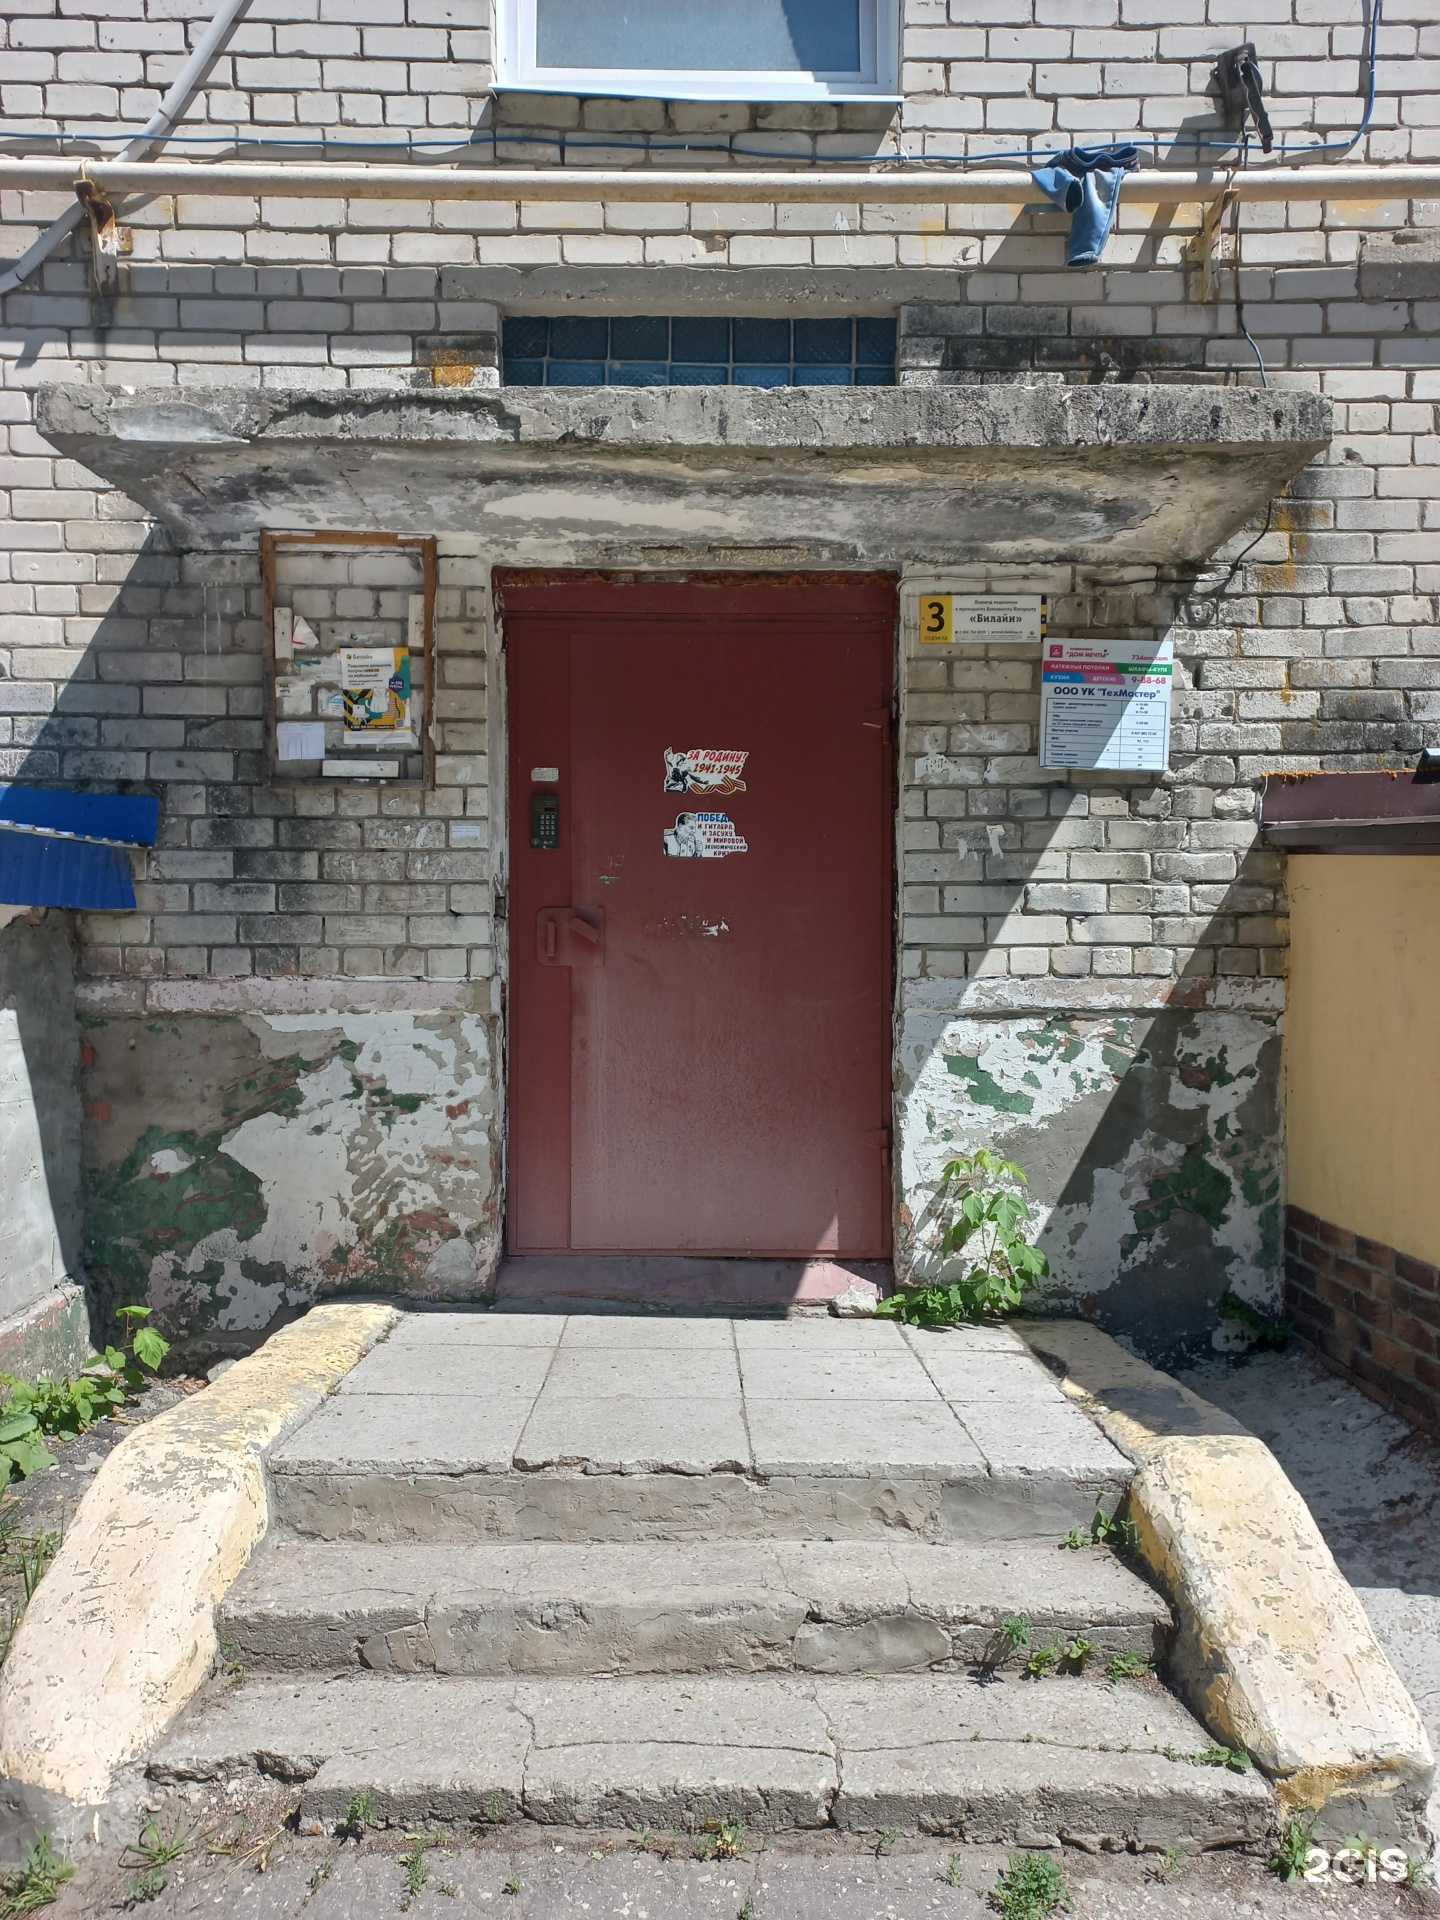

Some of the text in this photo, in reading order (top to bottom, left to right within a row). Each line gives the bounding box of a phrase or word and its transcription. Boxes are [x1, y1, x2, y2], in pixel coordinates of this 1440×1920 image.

[926, 601, 945, 632] 3
[969, 613, 1022, 623] «Билайн»
[1054, 687, 1161, 700] ООО УК "ТехМастер"
[688, 751, 749, 764] ЗА РОДИНУ!
[697, 813, 729, 823] ПОБЕД
